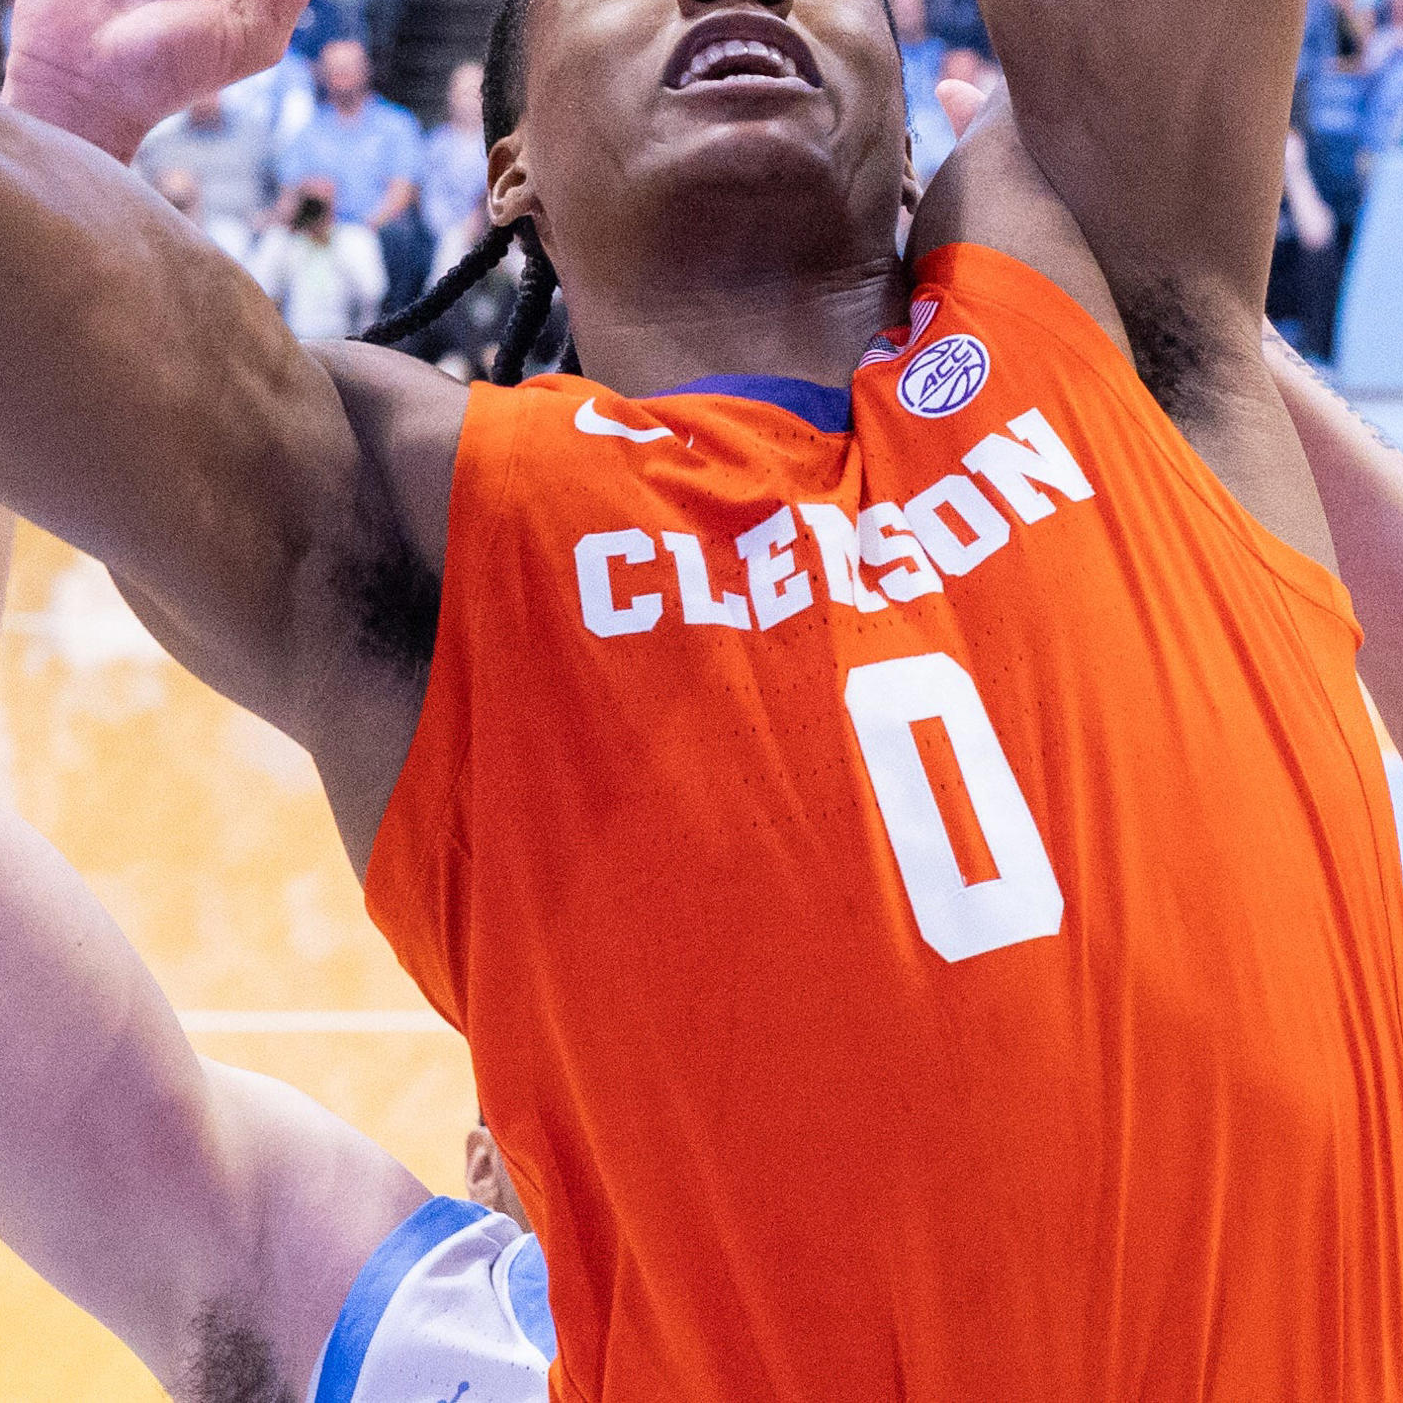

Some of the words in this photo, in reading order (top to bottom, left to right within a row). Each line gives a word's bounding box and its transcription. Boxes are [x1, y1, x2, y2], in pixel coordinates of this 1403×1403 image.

[919, 339, 971, 400] ACC
[574, 407, 1096, 639] CLEMSON
[844, 651, 1065, 964] 0
